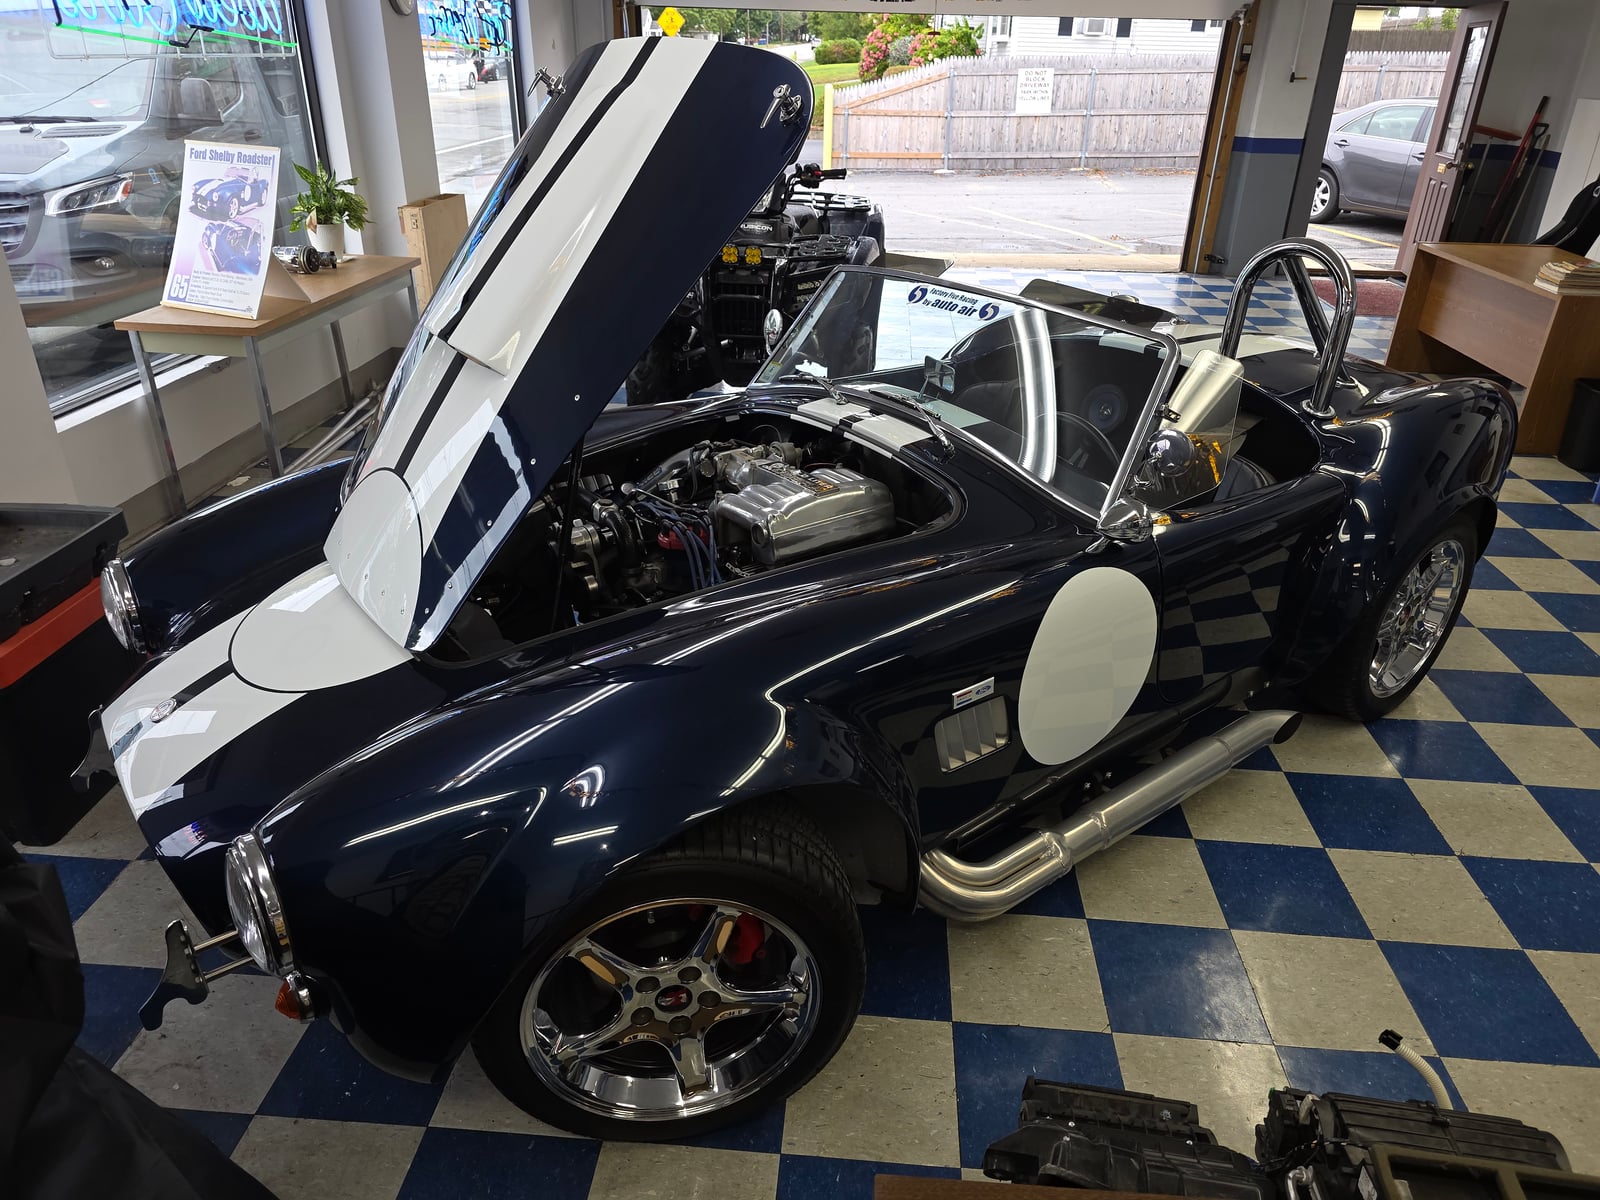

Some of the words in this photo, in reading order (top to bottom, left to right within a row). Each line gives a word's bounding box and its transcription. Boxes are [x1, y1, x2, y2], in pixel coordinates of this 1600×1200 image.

[190, 148, 207, 160] Ford
[209, 150, 235, 164] Shelby
[237, 152, 272, 166] Roadster
[170, 274, 190, 298] 65
[930, 288, 948, 298] Factory
[947, 292, 959, 300] Five
[958, 294, 979, 305] Racing
[922, 298, 932, 306] by
[931, 299, 958, 312] auto
[957, 304, 978, 317] air
